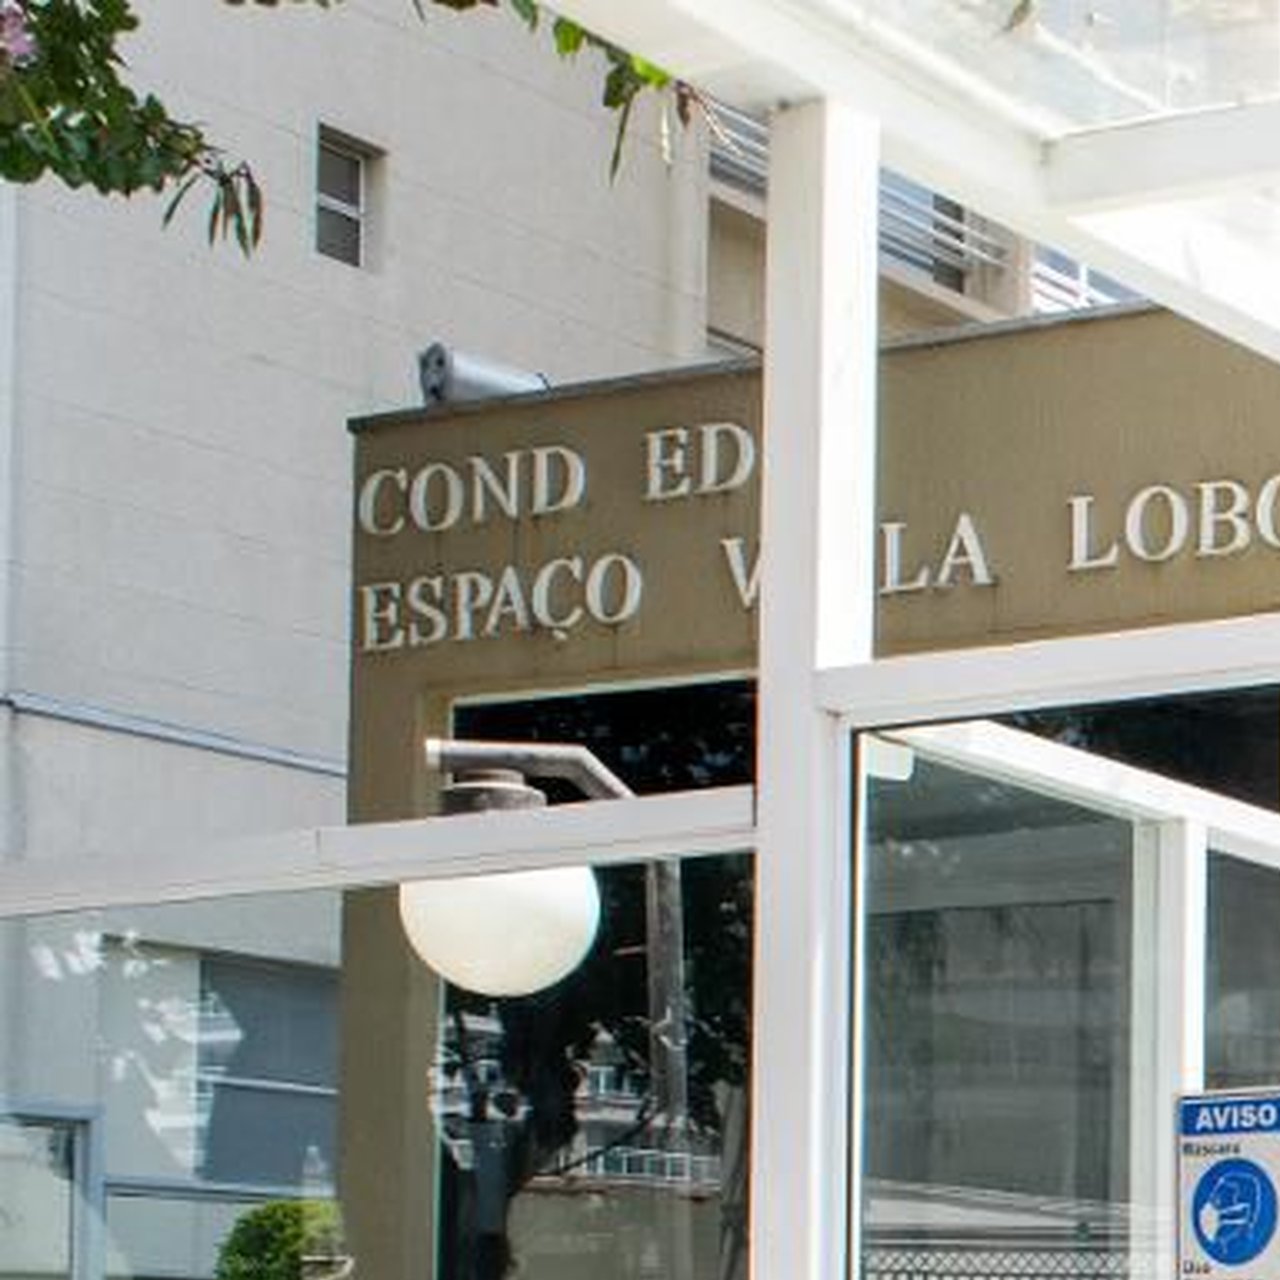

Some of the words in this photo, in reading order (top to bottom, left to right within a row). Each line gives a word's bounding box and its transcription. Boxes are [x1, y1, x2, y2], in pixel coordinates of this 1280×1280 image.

[357, 443, 587, 536] COND
[644, 421, 757, 501] ED
[360, 551, 644, 652] ESPAÇO
[720, 512, 996, 610] VLA
[1195, 1103, 1278, 1131] AVISO
